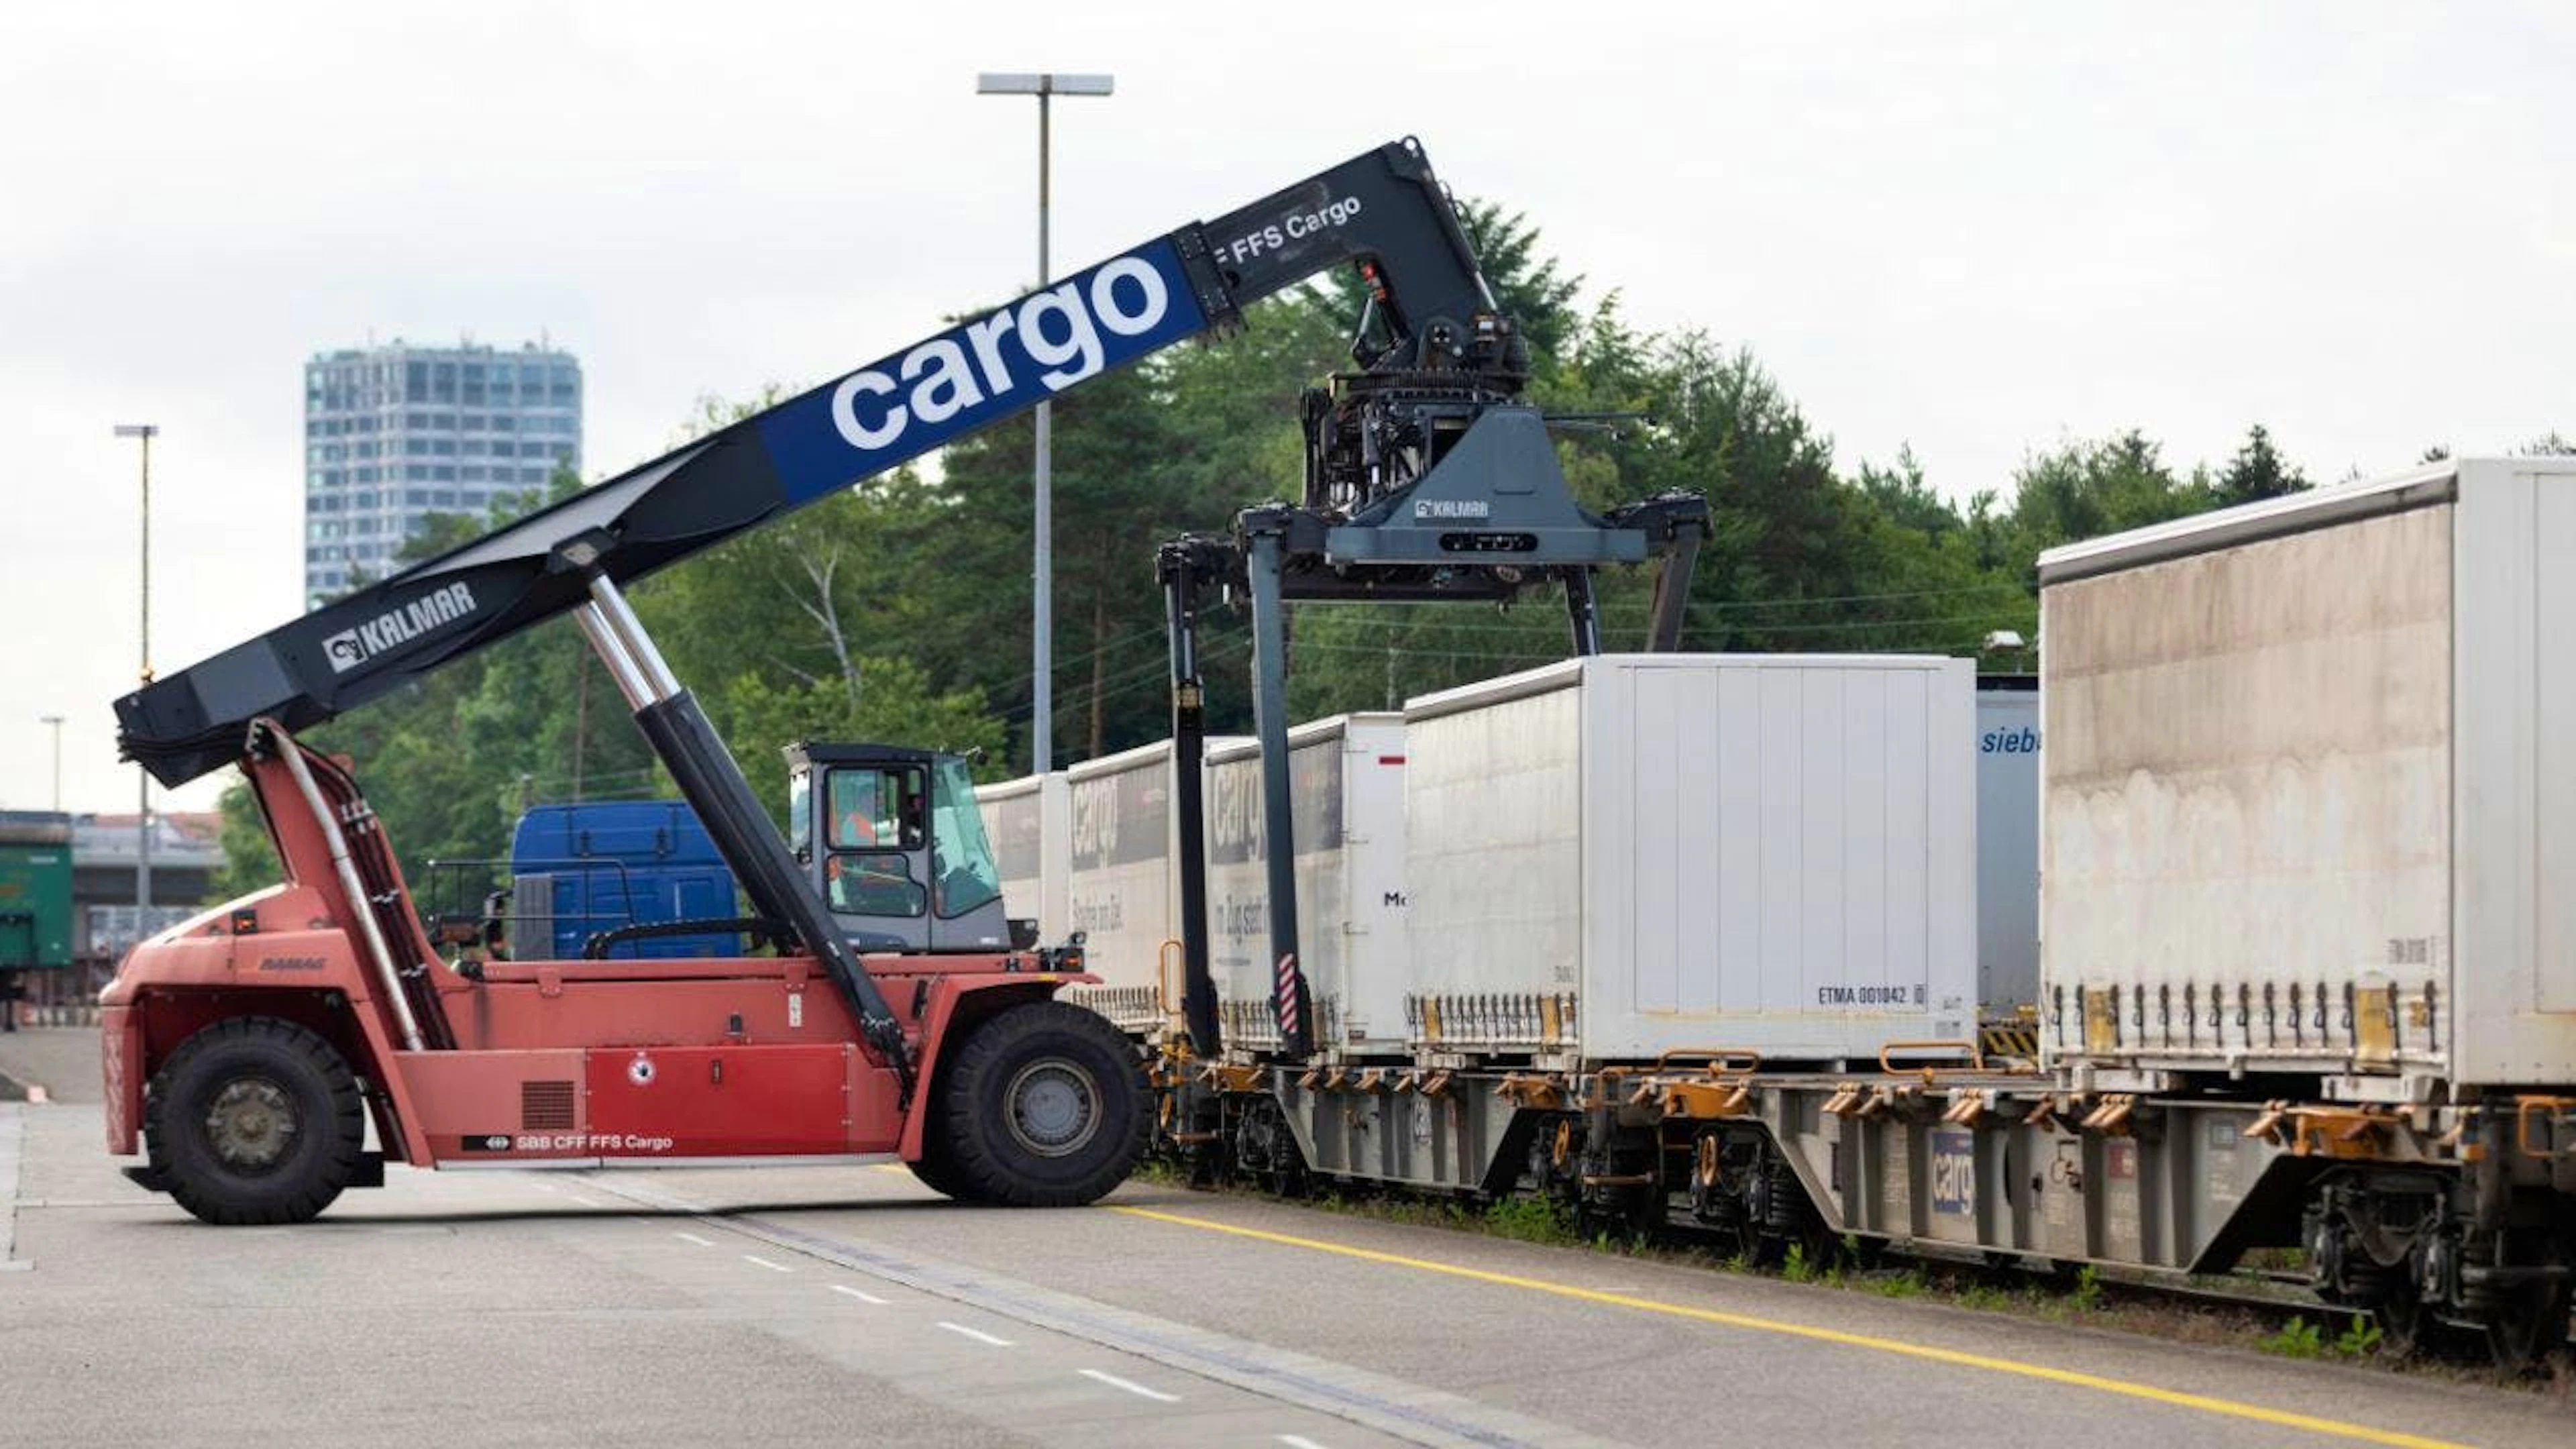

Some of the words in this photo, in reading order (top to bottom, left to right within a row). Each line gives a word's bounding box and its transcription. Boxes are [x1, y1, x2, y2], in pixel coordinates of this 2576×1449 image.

[1231, 225, 1284, 264] FFS
[1286, 196, 1361, 239] Cargo
[832, 256, 1169, 451] cargo
[1434, 500, 1489, 518] KALMAR
[360, 581, 478, 655] KALMAR
[1982, 727, 2040, 753] sieb
[1215, 765, 1267, 865] carg
[1819, 987, 1856, 1004] ETMA
[1858, 987, 1907, 1004] 001042
[517, 1135, 551, 1149] SBB
[555, 1135, 587, 1148] CFF
[589, 1134, 621, 1148] FFS
[625, 1134, 674, 1150] Cargo
[1933, 1152, 1975, 1215] carg
